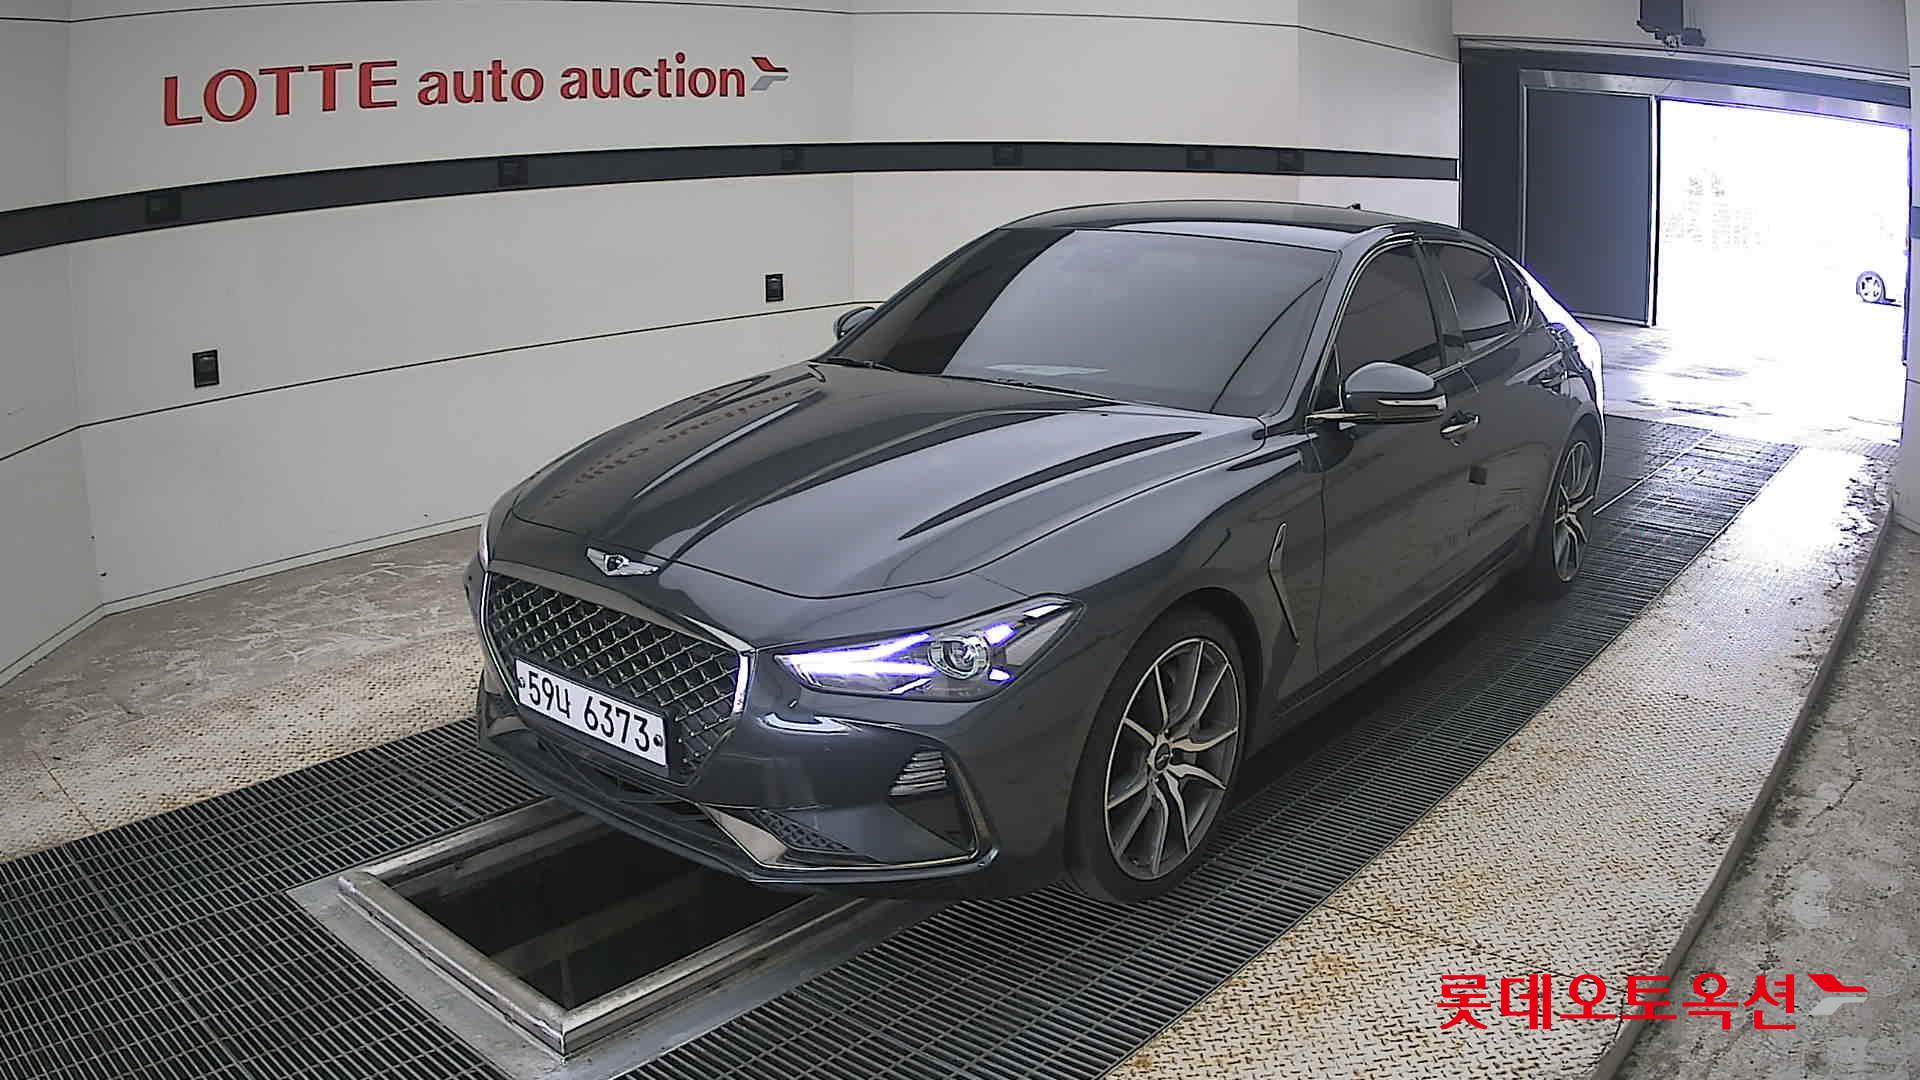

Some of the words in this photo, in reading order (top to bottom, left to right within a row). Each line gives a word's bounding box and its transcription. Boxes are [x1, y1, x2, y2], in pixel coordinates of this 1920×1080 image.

[163, 60, 398, 126] LOTTE
[417, 59, 544, 105] auto
[559, 52, 746, 99] auction
[583, 695, 650, 752] 6373
